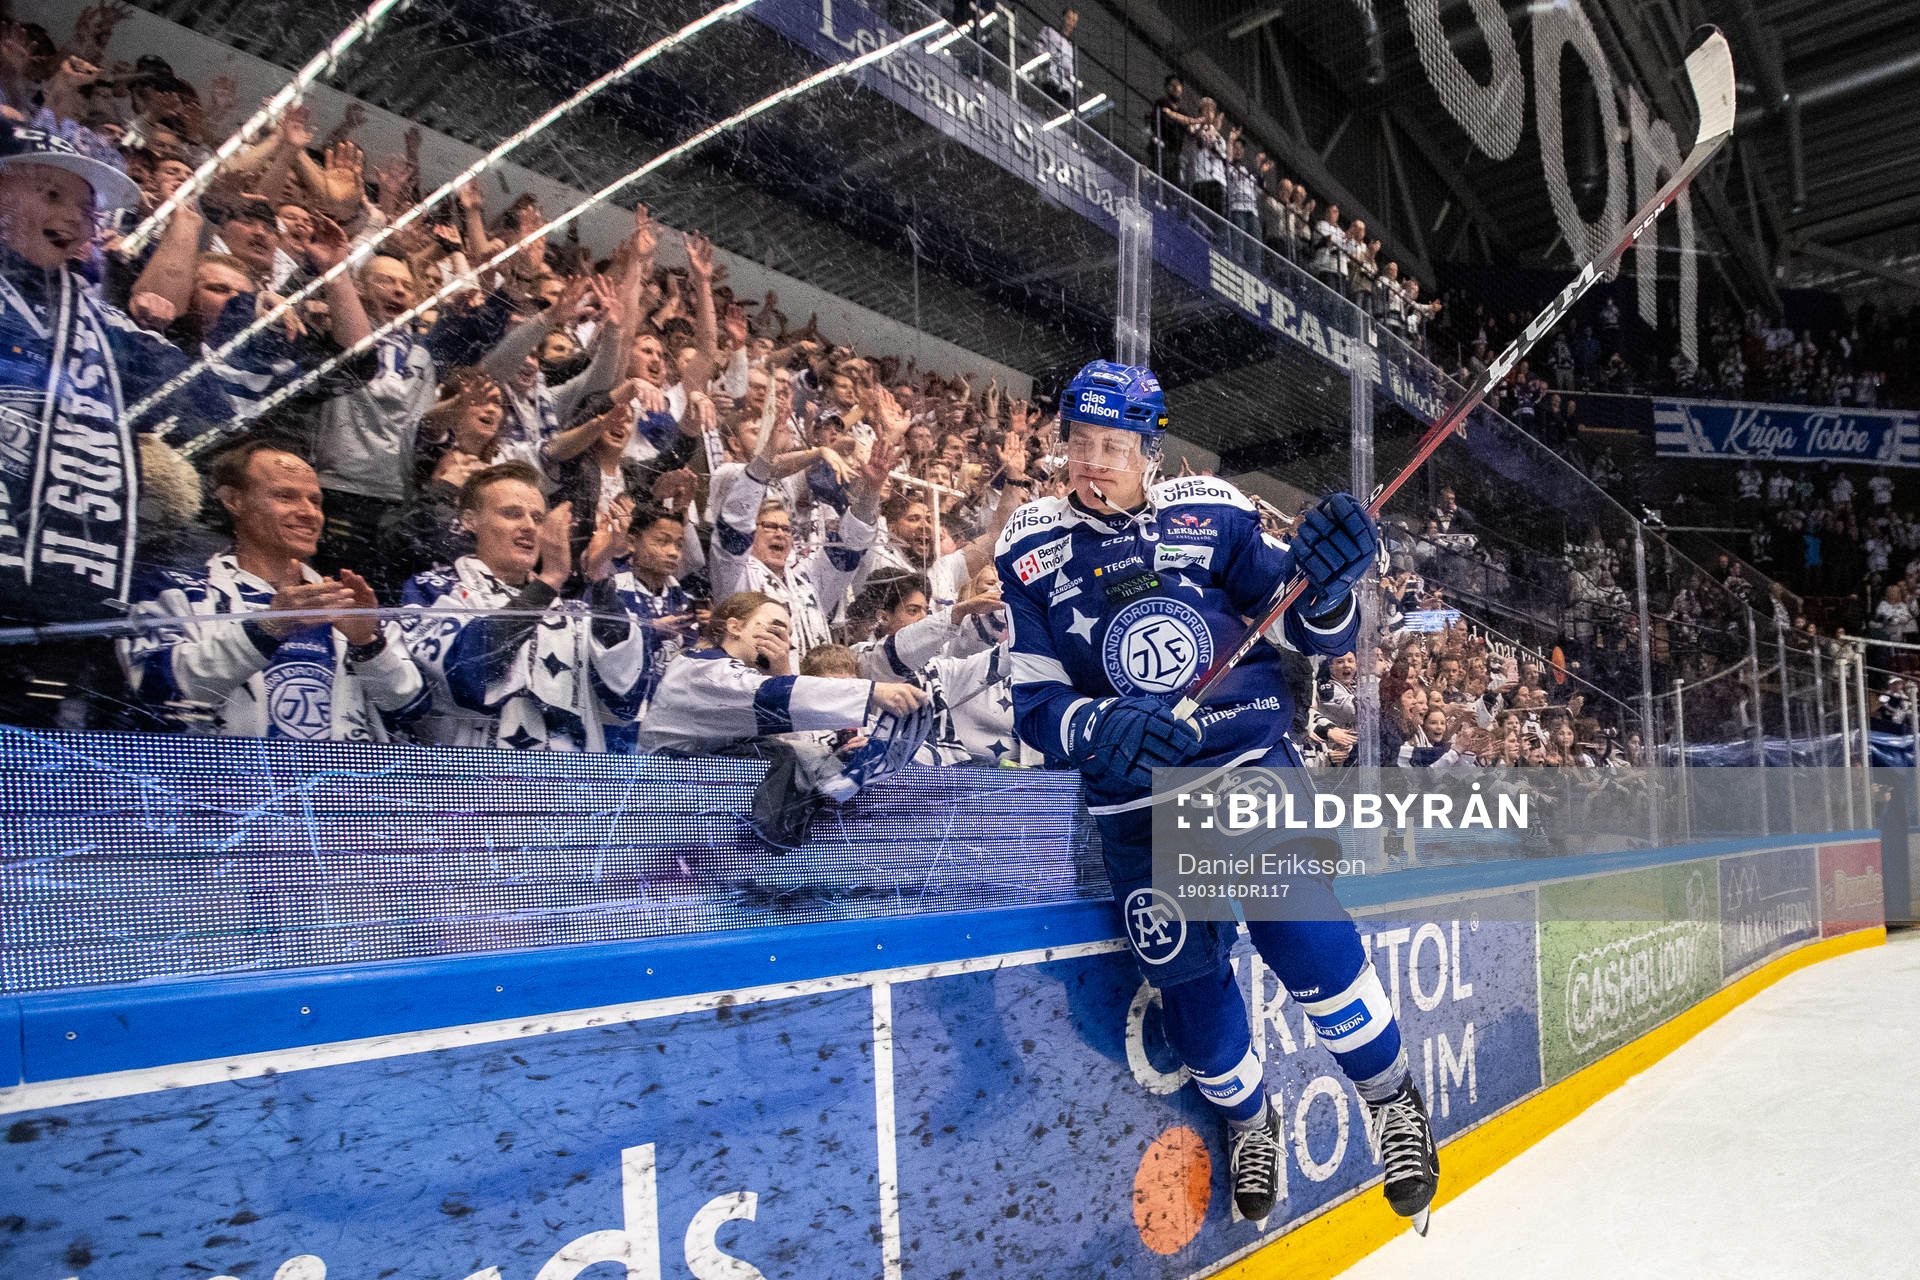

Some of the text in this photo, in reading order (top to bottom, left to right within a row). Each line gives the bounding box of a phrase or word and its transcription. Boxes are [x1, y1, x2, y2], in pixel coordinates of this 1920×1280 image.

[1632, 202, 1666, 239] CCM
[1081, 390, 1106, 405] clas
[1079, 403, 1120, 419] ohlson
[1722, 408, 1870, 460] Kriga Tobbe
[1101, 535, 1135, 547] CCM
[1167, 528, 1218, 537] LEKSANDS
[1106, 625, 1134, 694] LEKSANDS
[1229, 631, 1261, 668] CCM
[1291, 986, 1319, 997] CCM
[1571, 932, 1701, 1035] CASHBUDDY
[1335, 1014, 1364, 1035] HEDIN
